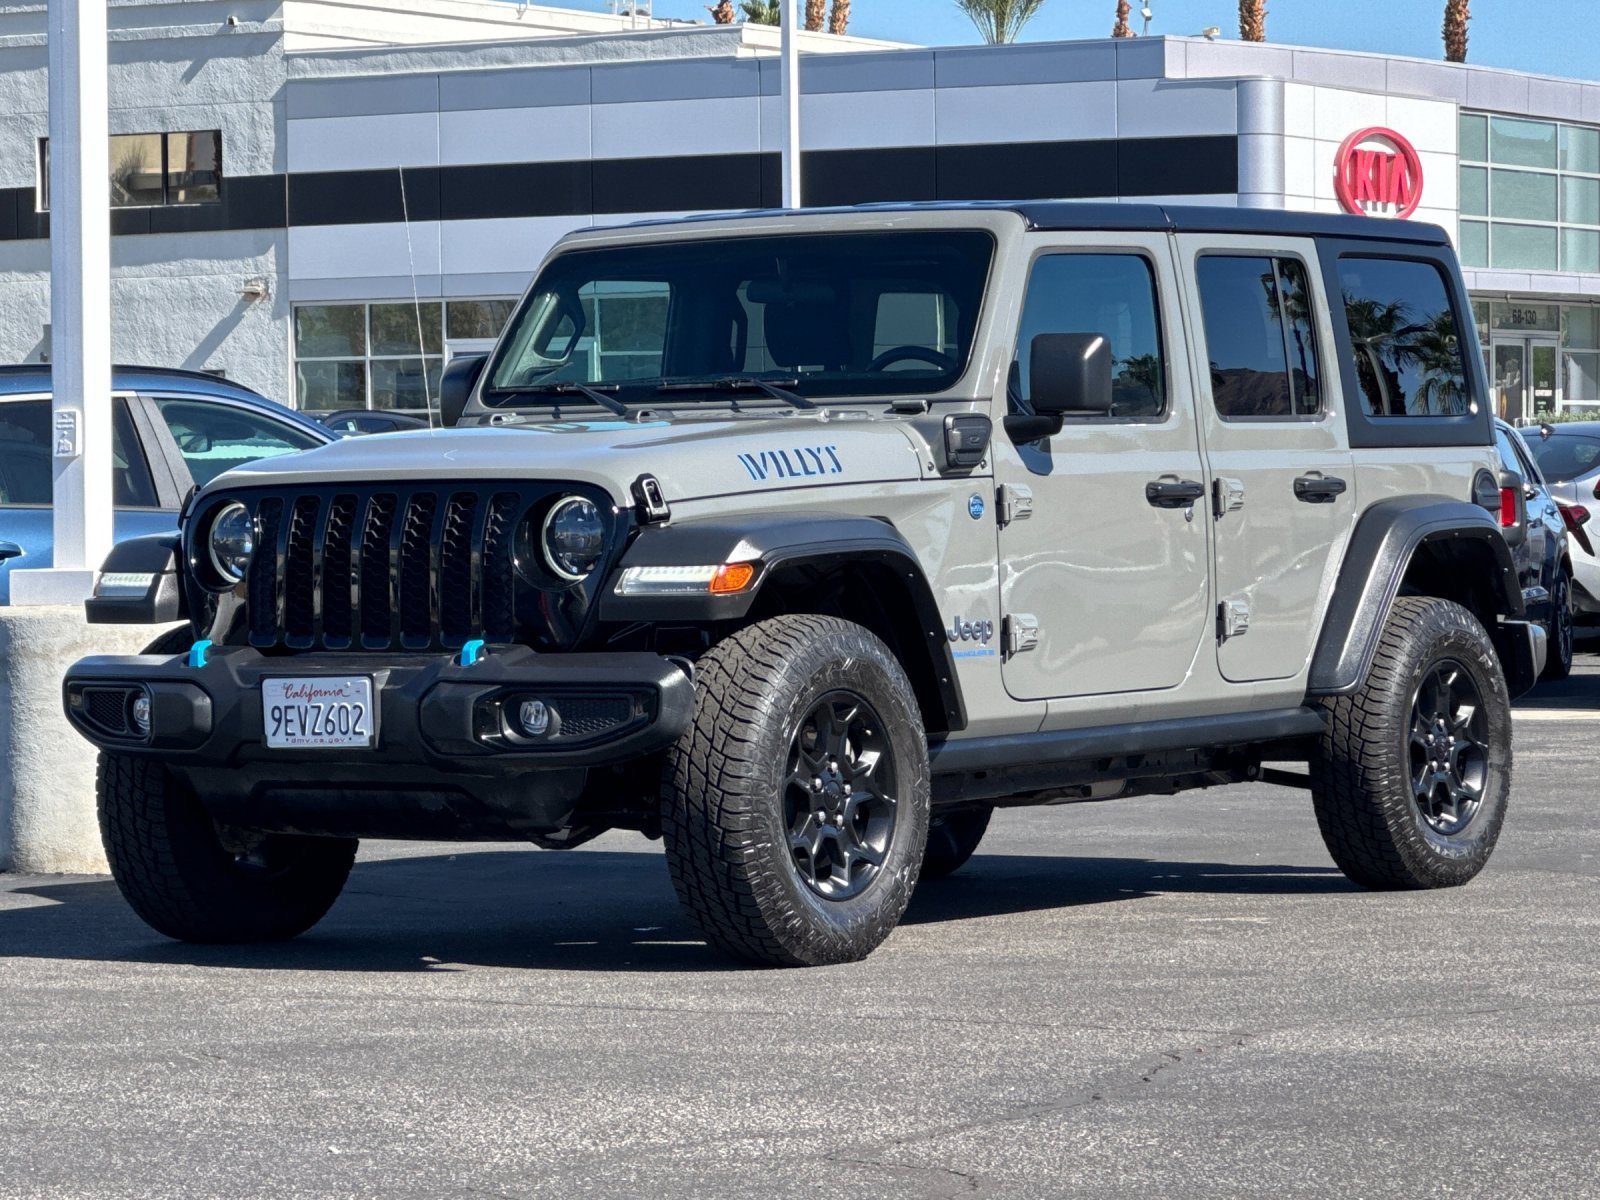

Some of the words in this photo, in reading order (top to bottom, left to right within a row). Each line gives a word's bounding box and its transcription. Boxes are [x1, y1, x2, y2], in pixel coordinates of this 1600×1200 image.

[1354, 149, 1410, 206] KIA
[737, 445, 842, 481] WILLYS
[947, 615, 993, 645] Jeep
[283, 683, 350, 703] California
[270, 703, 366, 737] 9EVZ602
[291, 736, 346, 744] dmv.ca.gov
